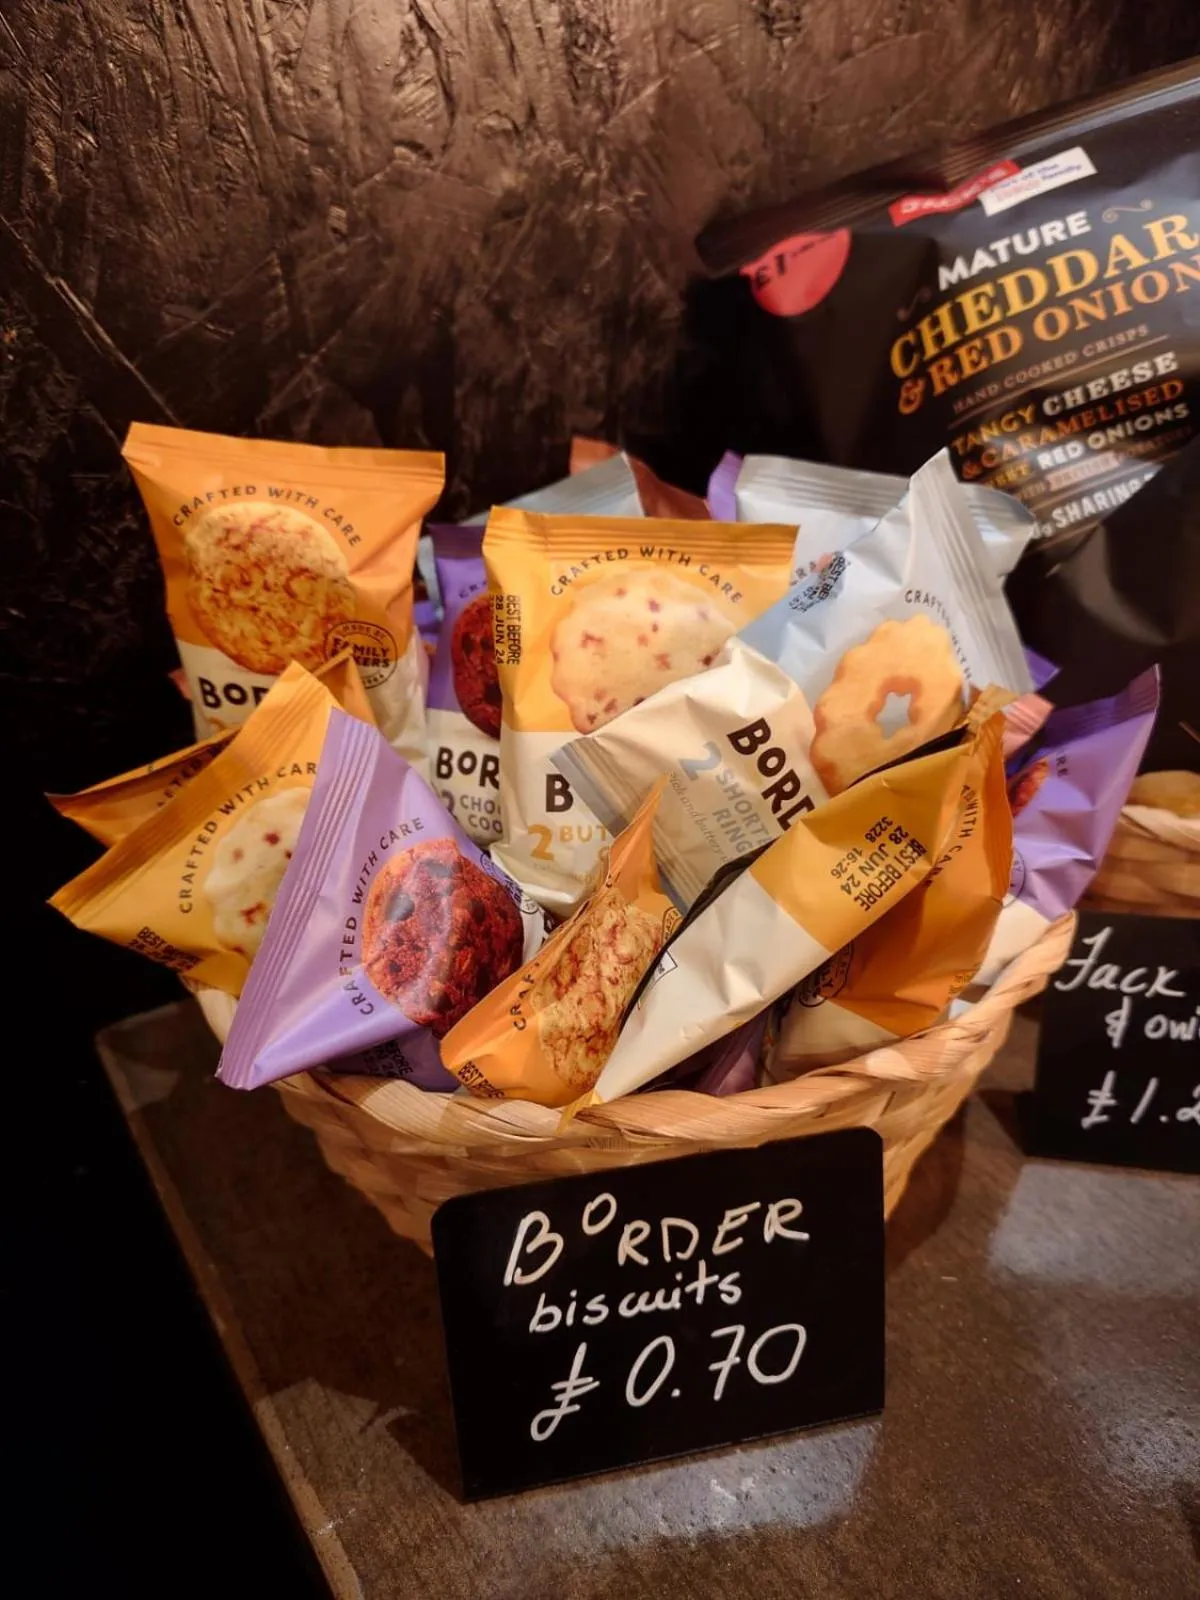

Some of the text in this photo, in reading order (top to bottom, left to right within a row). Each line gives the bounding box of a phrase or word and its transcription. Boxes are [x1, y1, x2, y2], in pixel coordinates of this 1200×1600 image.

[938, 211, 1093, 291] MATURE
[890, 214, 1200, 379] CHEDDAR
[898, 377, 925, 415] &
[928, 325, 1023, 397] RED
[952, 351, 1180, 456] TANGY CHEESE
[953, 323, 1150, 414] HAND COOKED CRISPS
[980, 379, 1185, 469] CARAMELISED
[1036, 441, 1085, 471] RED
[1087, 402, 1190, 450] ONIONS
[172, 484, 362, 547] CRAFTED WITH CARE
[495, 594, 504, 610] 28
[550, 547, 630, 597] CRAFTED
[639, 544, 691, 568] WITH
[699, 563, 743, 604] CARE
[495, 615, 505, 645] JUN
[506, 594, 521, 665] BEST BEFORE
[678, 740, 723, 782] 2
[179, 819, 218, 914] CRAFTED
[218, 776, 270, 817] WITH
[527, 824, 556, 862] 2
[830, 816, 893, 879] 3228 16:26
[840, 825, 909, 895] 28 JUN 24
[854, 838, 928, 912] BEST BEFORE
[339, 816, 425, 1016] CRAFTED WITH CARE
[1054, 926, 1187, 998] Jack
[503, 1193, 811, 1287] BORDER
[529, 1259, 744, 1334] biscuits
